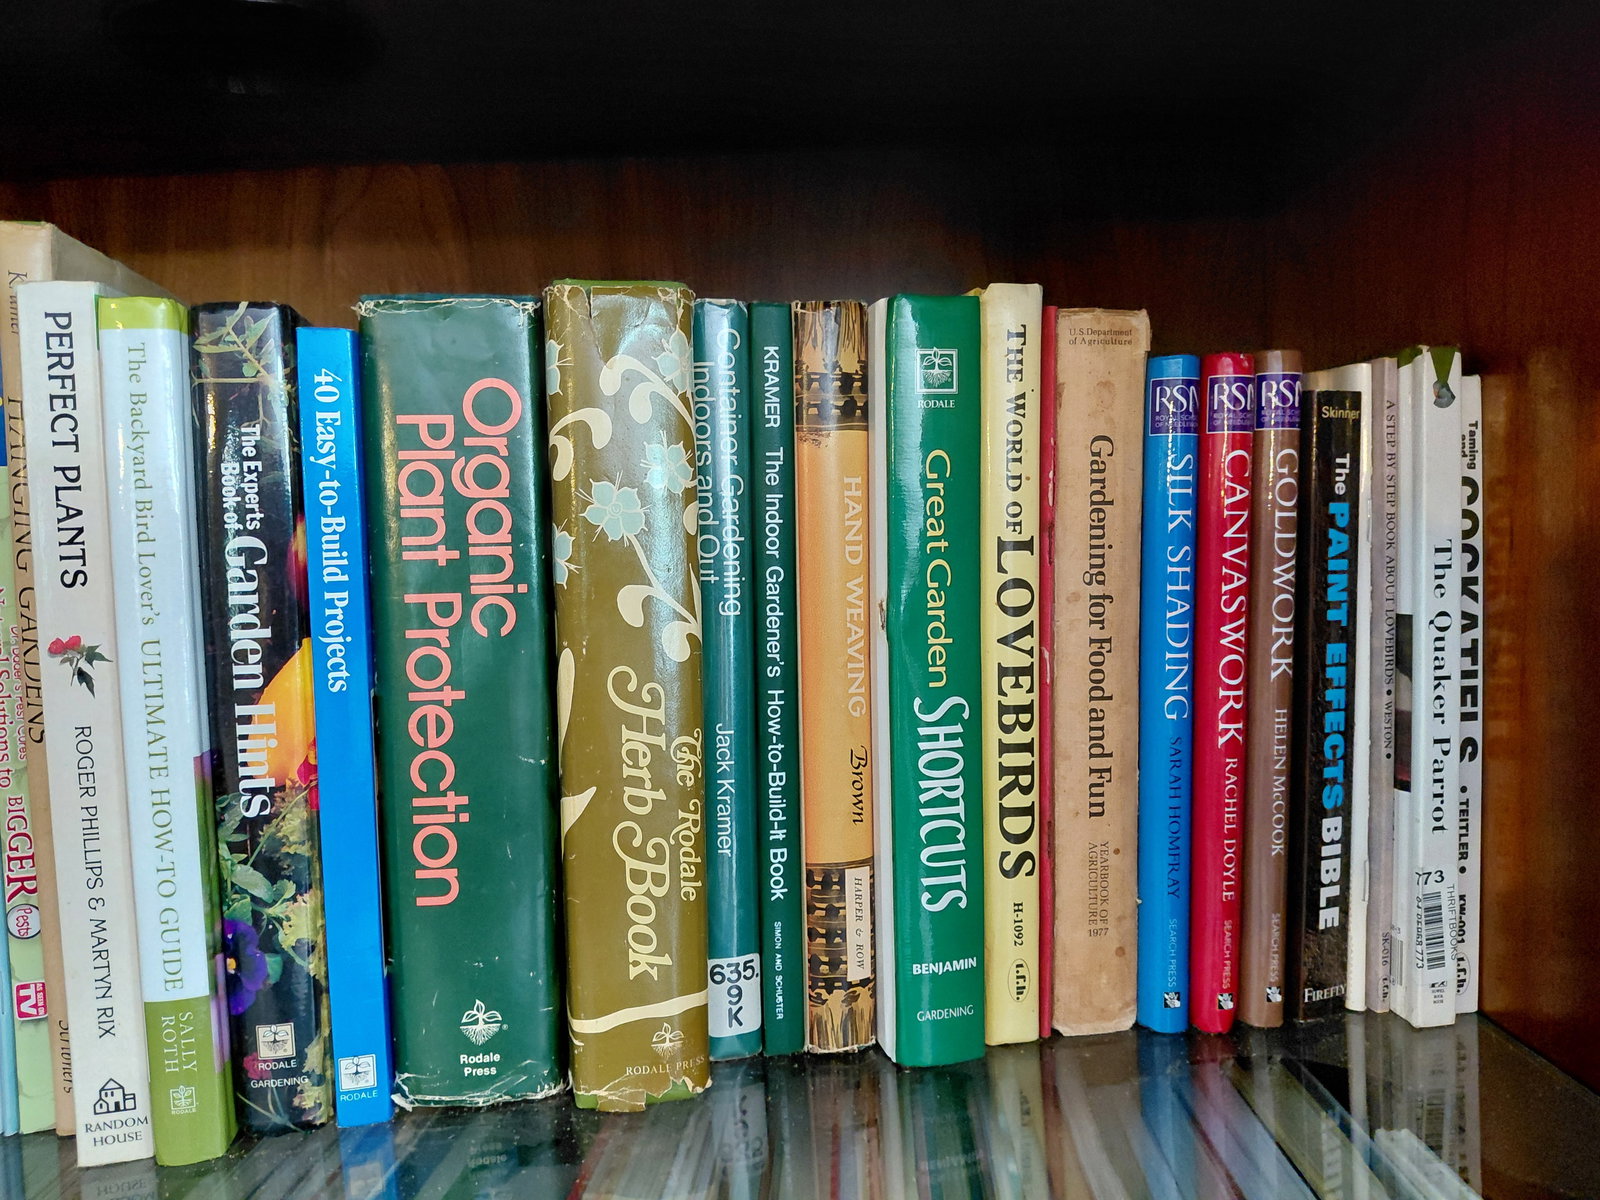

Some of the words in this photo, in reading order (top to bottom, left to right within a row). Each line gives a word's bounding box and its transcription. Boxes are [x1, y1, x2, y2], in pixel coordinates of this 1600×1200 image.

[127, 342, 147, 384] The
[1006, 324, 1027, 384] THE
[1069, 337, 1077, 345] of
[1080, 337, 1133, 346] Agriculture
[44, 311, 80, 453] PERFECT
[314, 368, 342, 403] 40
[716, 328, 741, 465] Container
[763, 346, 780, 428] KRAMER
[917, 399, 956, 409] RODALE
[1321, 406, 1360, 419] Skinner
[1386, 400, 1395, 410] A
[129, 392, 154, 490] Backyard
[240, 424, 260, 457] The
[693, 361, 716, 466] Indoors
[1005, 391, 1027, 493] WORLD
[1386, 414, 1396, 448] STEP
[765, 447, 783, 486] The
[1334, 453, 1350, 495] The
[1386, 452, 1396, 471] BY
[1467, 420, 1479, 470] Taming
[220, 462, 241, 509] Book
[243, 461, 264, 530] Experts
[310, 411, 349, 583] Easy-to-Build
[396, 414, 460, 566] Plant
[451, 377, 528, 637] Organic
[697, 475, 719, 526] and
[925, 449, 951, 554] Great
[1083, 434, 1115, 586] Gardening
[1168, 453, 1193, 533] SILK
[1386, 474, 1396, 510] STEP
[53, 464, 88, 589] PLANTS
[134, 499, 156, 544] Bird
[223, 512, 243, 531] of
[719, 473, 746, 616] Gardening
[765, 494, 783, 558] Indoor
[842, 476, 862, 566] HAND
[1005, 501, 1023, 535] OF
[1385, 513, 1396, 549] BOOK
[137, 552, 161, 625] Lover's
[699, 534, 720, 583] Out
[1271, 449, 1299, 682] GOLDWORK
[1327, 502, 1349, 627] PAINT
[1385, 555, 1396, 603] ABOUT
[1433, 538, 1452, 599] The
[225, 535, 272, 691] Garden
[765, 566, 785, 677] Gardener's
[925, 558, 953, 688] Garden
[1089, 593, 1114, 630] for
[1218, 450, 1250, 749] CANVASWORK
[318, 590, 352, 692] Projects
[845, 577, 867, 718] WEAVING
[1164, 545, 1191, 720] SHADING
[1384, 608, 1395, 685] LOVEBIRDS
[1088, 635, 1113, 704] Food
[1428, 610, 1452, 725] Quaker
[140, 639, 169, 779] ULTIMATE
[996, 535, 1036, 879] LOVEBIRDS
[1088, 708, 1113, 761] and
[1322, 643, 1347, 810] EFFECTS
[1384, 701, 1395, 752] WESTON
[74, 725, 96, 799] ROGER
[234, 702, 278, 818] Hints
[403, 592, 470, 907] Protection
[606, 665, 667, 816] Herb
[670, 727, 703, 788] The
[716, 723, 735, 773] Jack
[767, 689, 786, 841] How-to-Build-It
[1168, 736, 1183, 799] SARAH
[1273, 709, 1287, 770] HELEN
[849, 745, 868, 824] Brown
[913, 695, 970, 913] SHORTCUTS
[1088, 766, 1113, 819] Fun
[1224, 758, 1238, 834] RACHEL
[1431, 736, 1452, 834] Parrot
[151, 788, 177, 898] HOW-TO
[716, 779, 735, 857] Kramer
[1271, 775, 1286, 856] McCOOK
[1458, 799, 1469, 861] TEITLER
[6, 796, 38, 902] BIGGER
[80, 805, 104, 890] PHILLIPS
[670, 798, 703, 902] Rodale
[769, 848, 788, 901] Book
[1099, 841, 1110, 909] YEARBOOK
[1167, 805, 1182, 898] HOMFRAY
[1223, 839, 1237, 902] DOYLE
[1319, 816, 1342, 930] BIBLE
[88, 897, 105, 911] &
[612, 820, 673, 981] Book
[854, 877, 863, 923] HARPER
[1088, 842, 1098, 925] AGRICULTURE
[16, 908, 32, 937] Pests
[774, 922, 782, 949] SIMON
[1013, 902, 1024, 947] H-1092
[1088, 928, 1109, 937] 1977
[1100, 911, 1109, 925] OF
[1169, 918, 1178, 956] SEARCH
[1224, 920, 1233, 958] SEARCH
[1272, 913, 1281, 951] SEARCH
[1447, 884, 1458, 960] THRIFTBOOKS
[89, 918, 114, 1005] MARTYN
[159, 908, 184, 992] GUIDE
[775, 953, 783, 970] AND
[855, 943, 865, 970] ROW
[912, 957, 977, 975] BENJAMIN
[1168, 959, 1177, 987] PRESS
[1223, 960, 1231, 989] PRESS
[1270, 953, 1279, 982] PRESS
[19, 984, 37, 1015] TV
[96, 1006, 116, 1039] RIX
[727, 985, 743, 1006] 9
[728, 1006, 743, 1028] K
[775, 975, 784, 1020] SCHUSTER
[917, 1005, 974, 1022] GARDENING
[161, 1016, 179, 1073] ROTH
[178, 1011, 197, 1072] SALLY
[258, 1059, 297, 1070] RODALE
[460, 1052, 501, 1065] Rodale
[464, 1066, 497, 1077] Press
[626, 1064, 672, 1075] RODALE
[251, 1075, 309, 1088] GARDENING
[340, 1090, 378, 1101] RODALE
[84, 1115, 149, 1133] RANDOM
[92, 1131, 143, 1147] HOUSE
